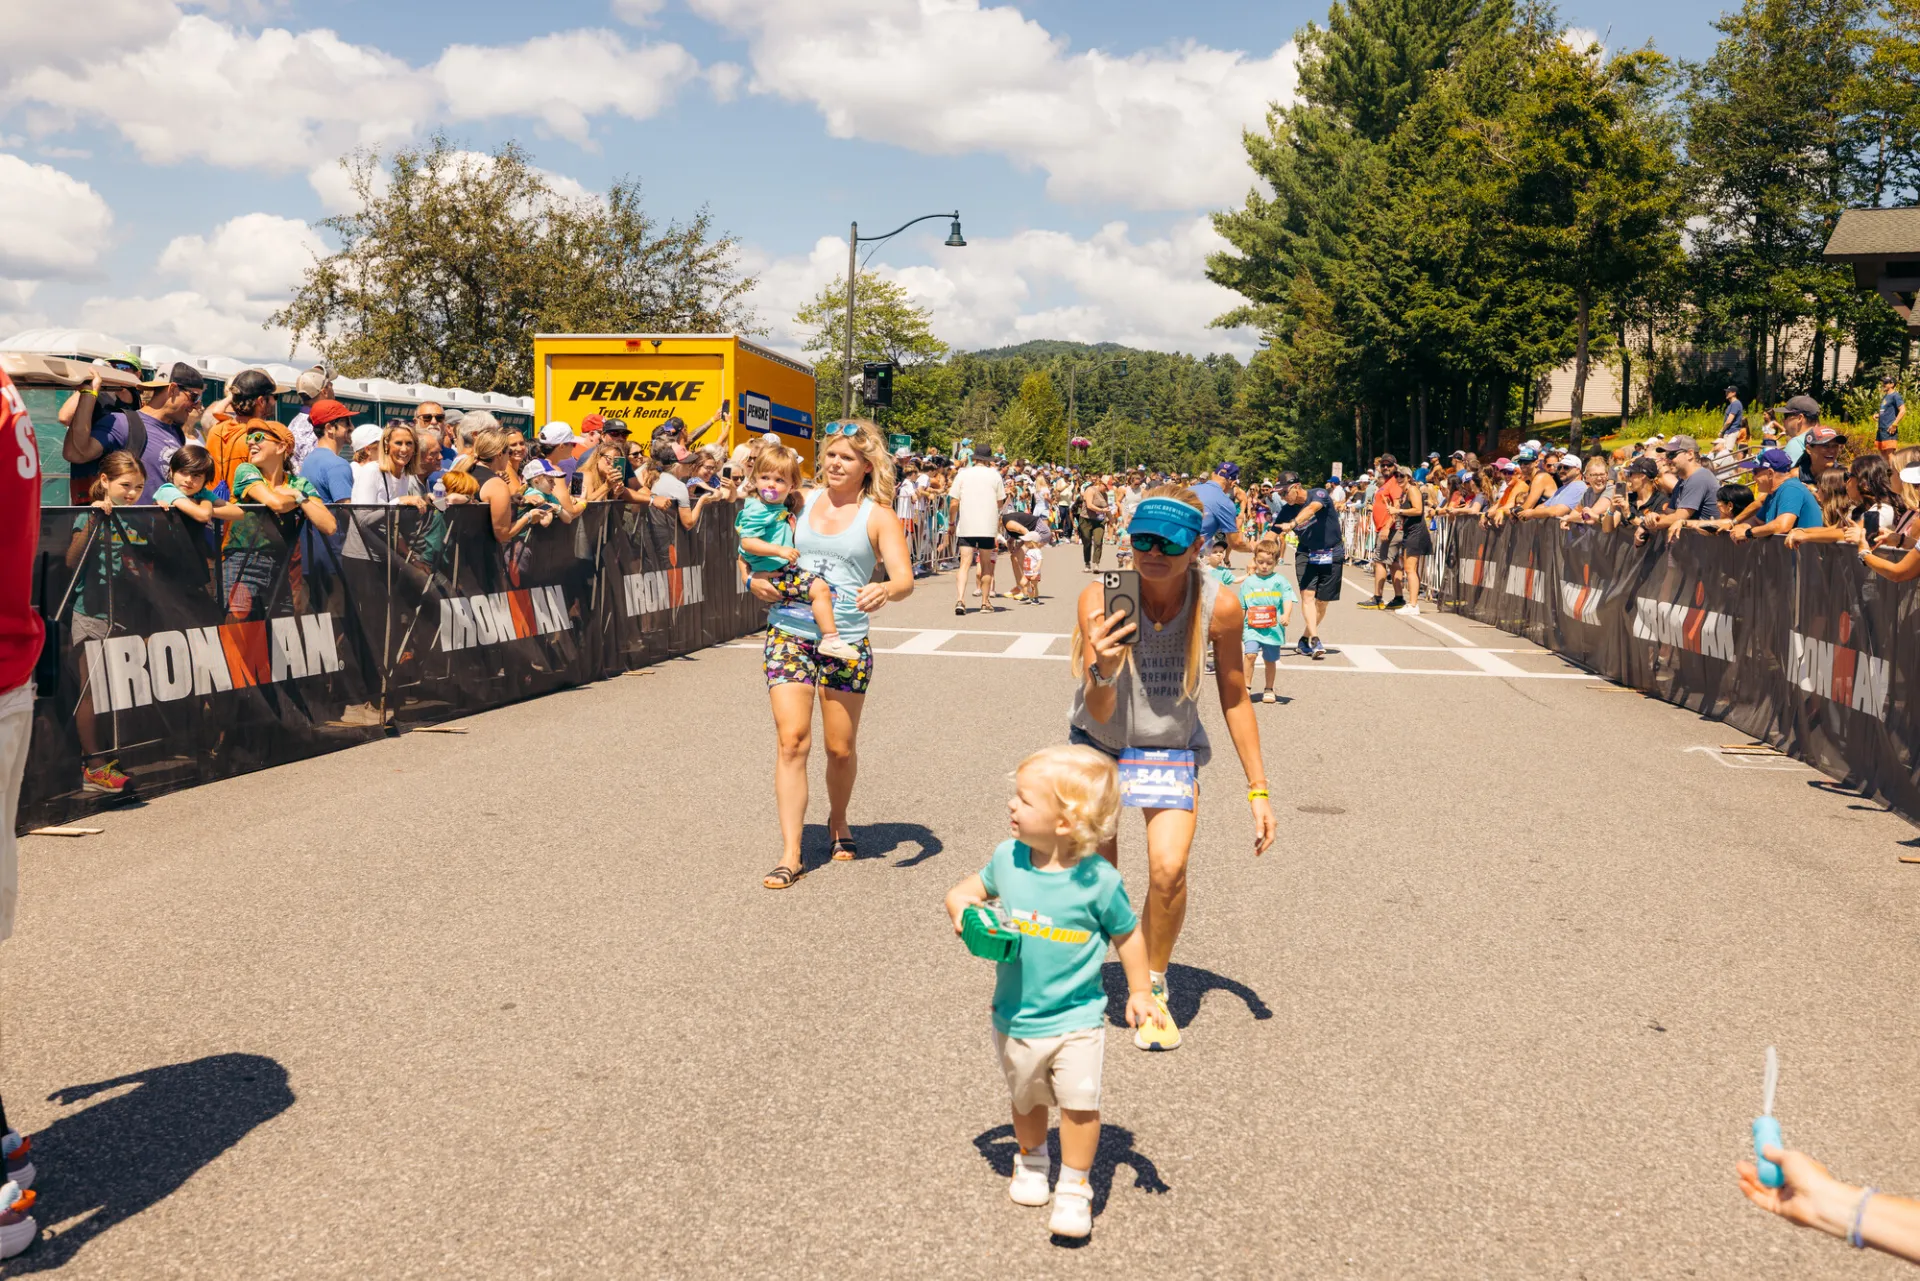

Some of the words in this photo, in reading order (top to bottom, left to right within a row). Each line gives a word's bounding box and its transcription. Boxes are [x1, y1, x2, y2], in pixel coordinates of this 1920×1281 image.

[568, 380, 704, 402] PENSKE
[598, 406, 631, 418] Truck
[633, 406, 676, 418] Rental
[747, 404, 769, 421] PENSKE
[624, 564, 705, 618] IRONMAN
[440, 584, 571, 652] IRONMAN
[1633, 597, 1736, 662] IRONMAN
[84, 612, 339, 715] IRONMAN
[1141, 656, 1185, 668] ATHLETIC
[1140, 687, 1180, 697] COMPAN
[1136, 768, 1177, 786] 544
